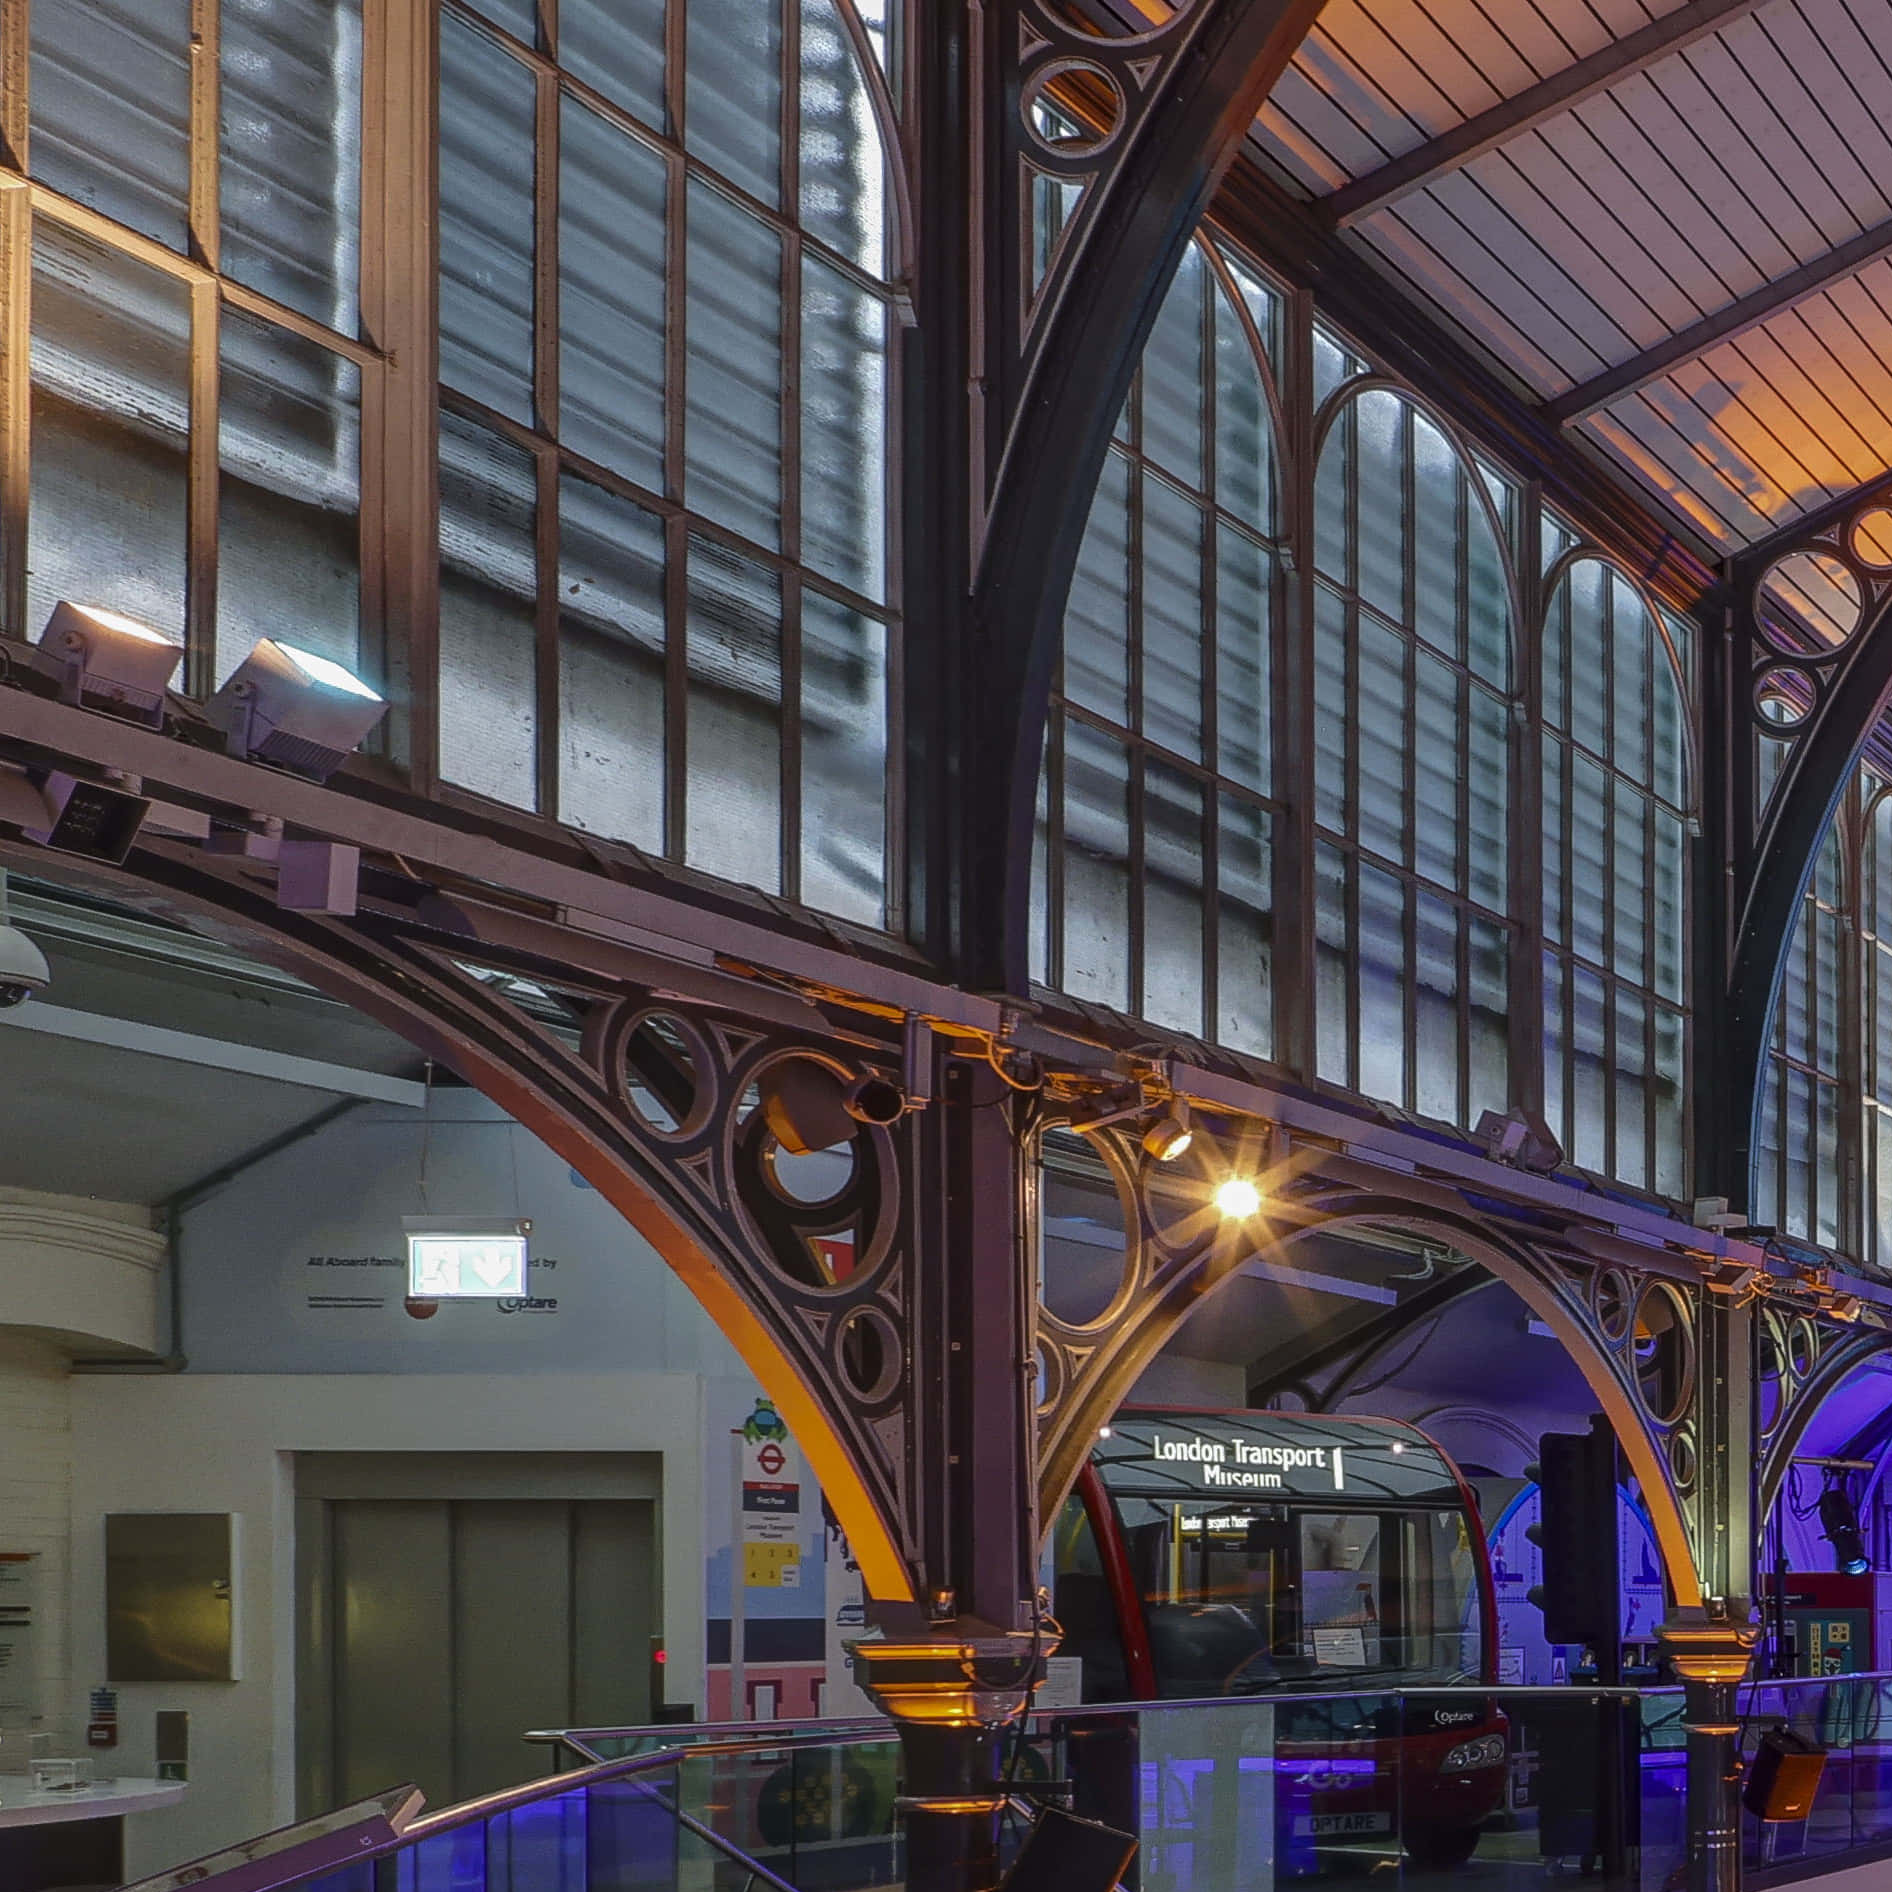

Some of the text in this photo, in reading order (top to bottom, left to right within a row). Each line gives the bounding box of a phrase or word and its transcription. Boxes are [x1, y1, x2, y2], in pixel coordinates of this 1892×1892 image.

[1154, 1436, 1225, 1463] London
[1232, 1439, 1325, 1472] Transport
[1203, 1465, 1281, 1489] Museum
[1440, 1711, 1475, 1723] Optare
[1310, 1814, 1375, 1832] OPTARE
